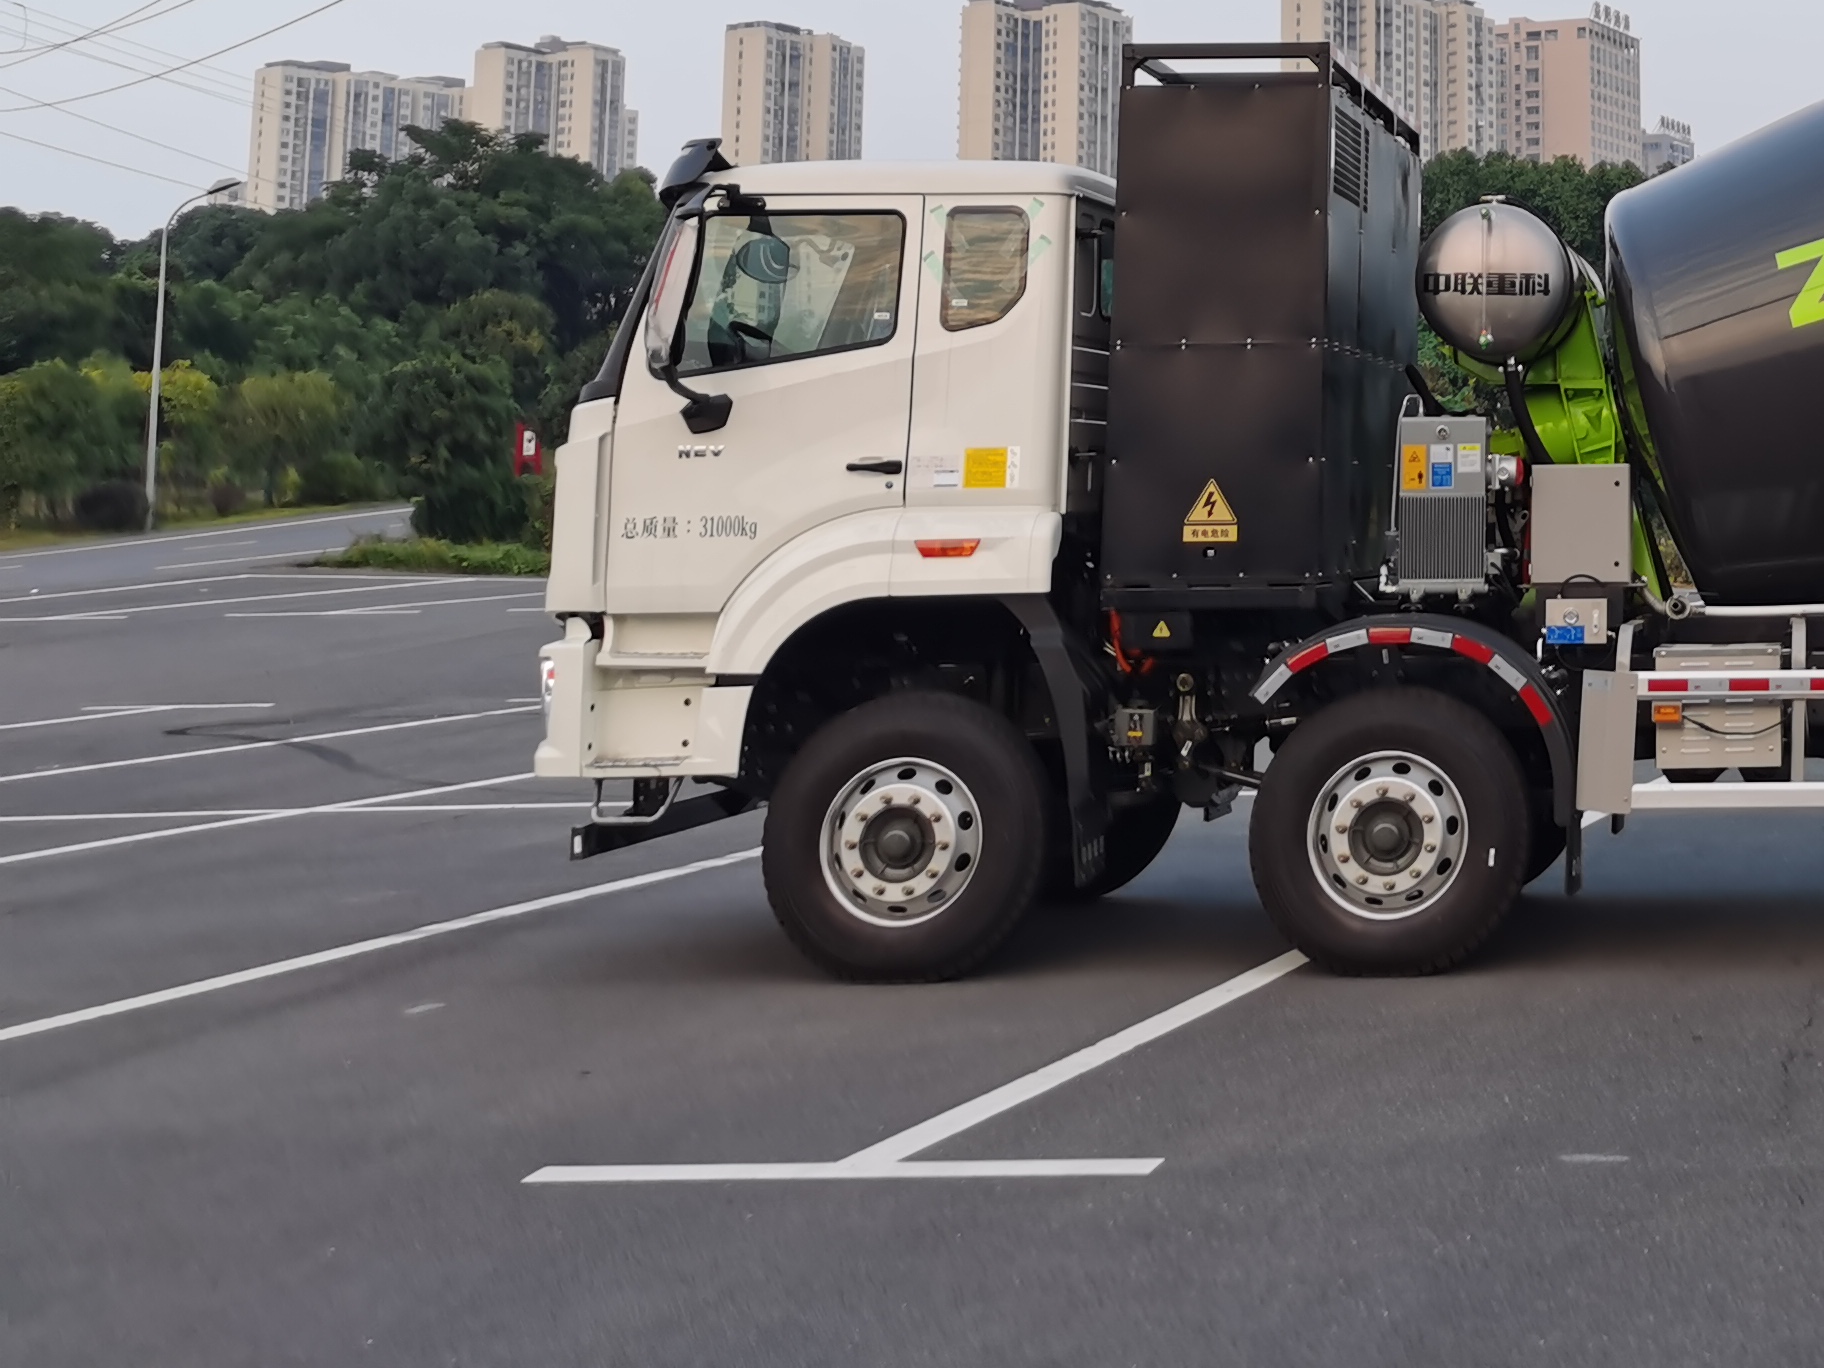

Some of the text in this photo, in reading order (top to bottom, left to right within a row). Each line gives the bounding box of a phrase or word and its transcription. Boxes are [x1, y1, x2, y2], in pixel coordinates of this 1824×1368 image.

[1423, 272, 1551, 296] 中联重科
[677, 444, 725, 459] NEV
